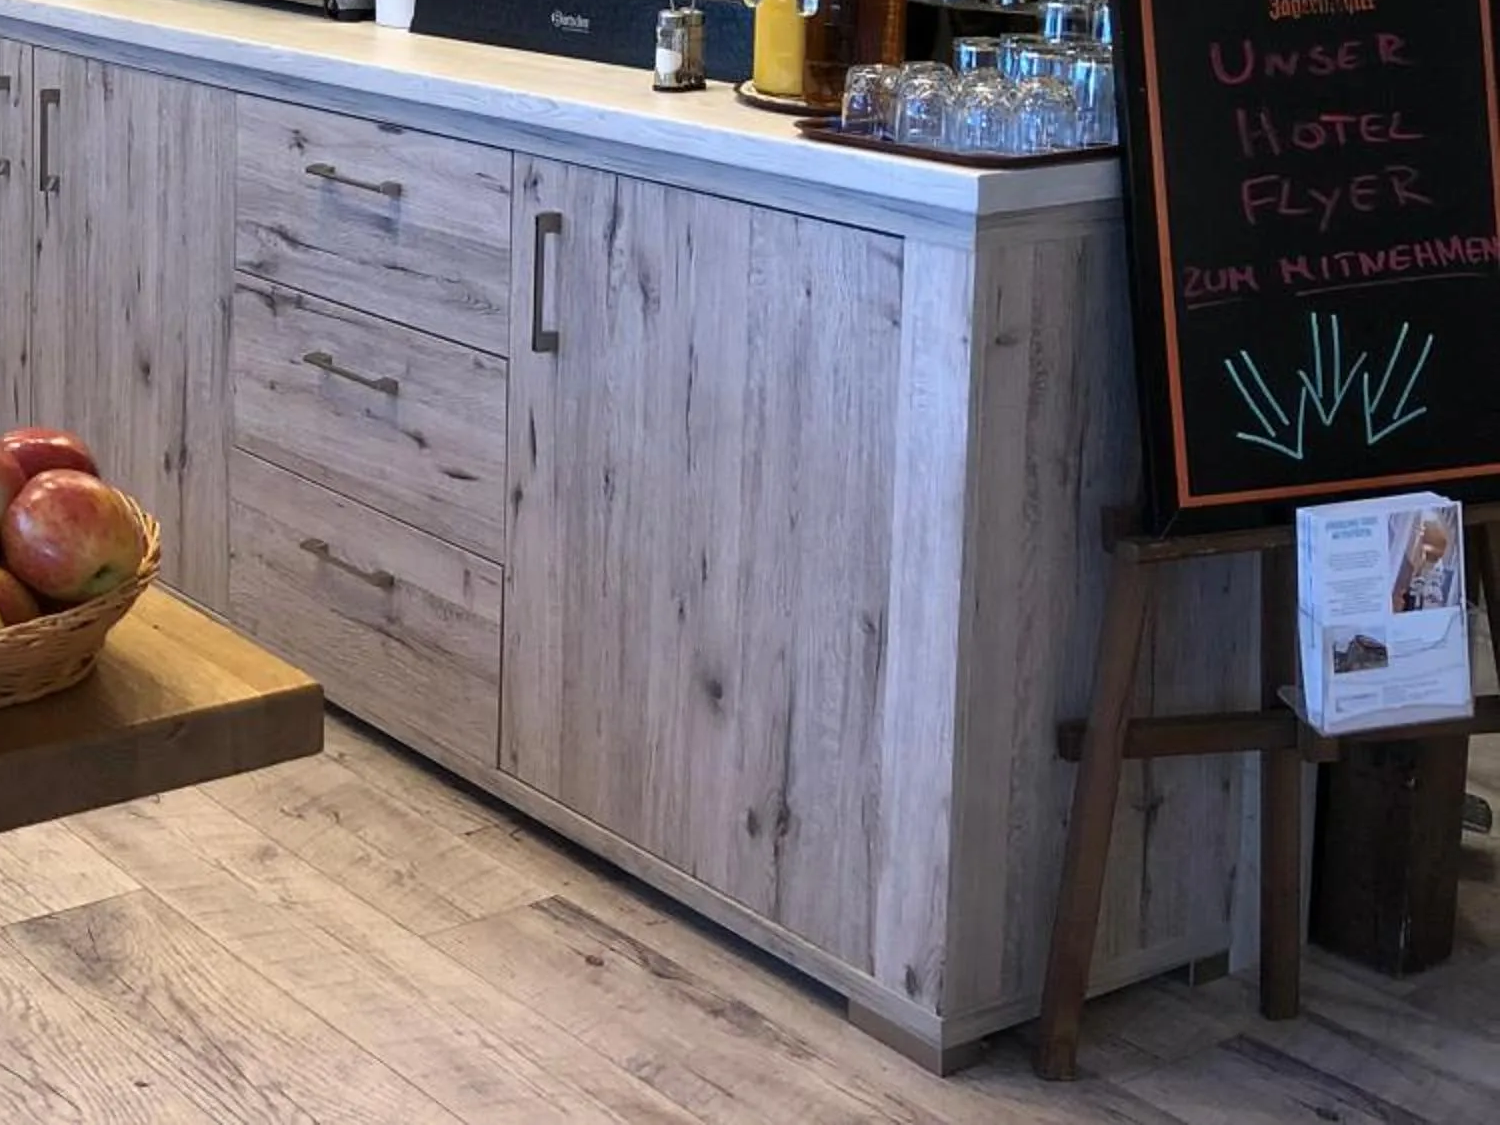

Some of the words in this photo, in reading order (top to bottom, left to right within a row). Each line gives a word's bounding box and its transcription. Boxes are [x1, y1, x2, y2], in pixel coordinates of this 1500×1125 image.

[1209, 31, 1415, 86] UNSER
[1235, 106, 1426, 159] HOTEL
[1240, 164, 1434, 234] FLYER
[1184, 266, 1260, 297] ZUM
[1277, 235, 1500, 285] MITNEHMEN
